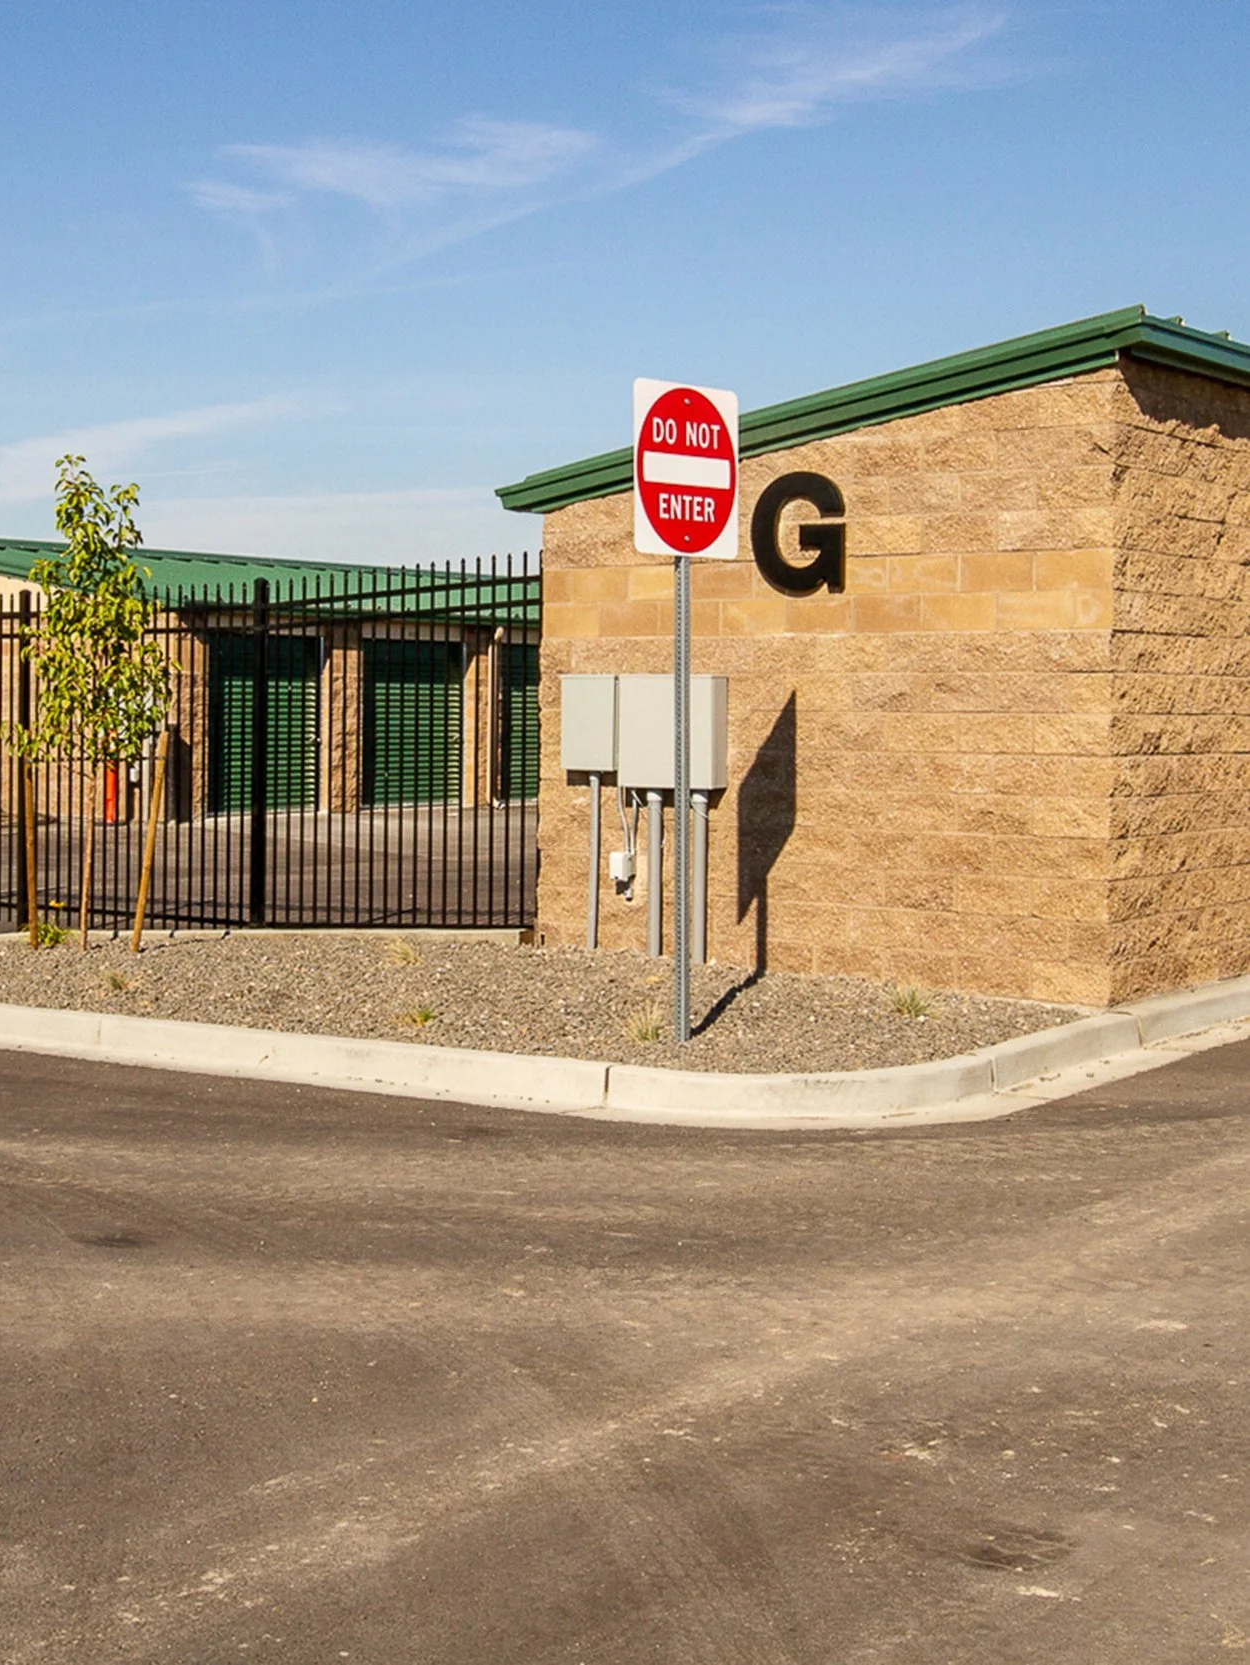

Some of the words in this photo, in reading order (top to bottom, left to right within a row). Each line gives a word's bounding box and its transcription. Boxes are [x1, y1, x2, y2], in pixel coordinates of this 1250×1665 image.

[653, 416, 677, 445] DO
[686, 421, 721, 450] NOT
[659, 493, 715, 522] ENTER
[751, 471, 845, 598] G
